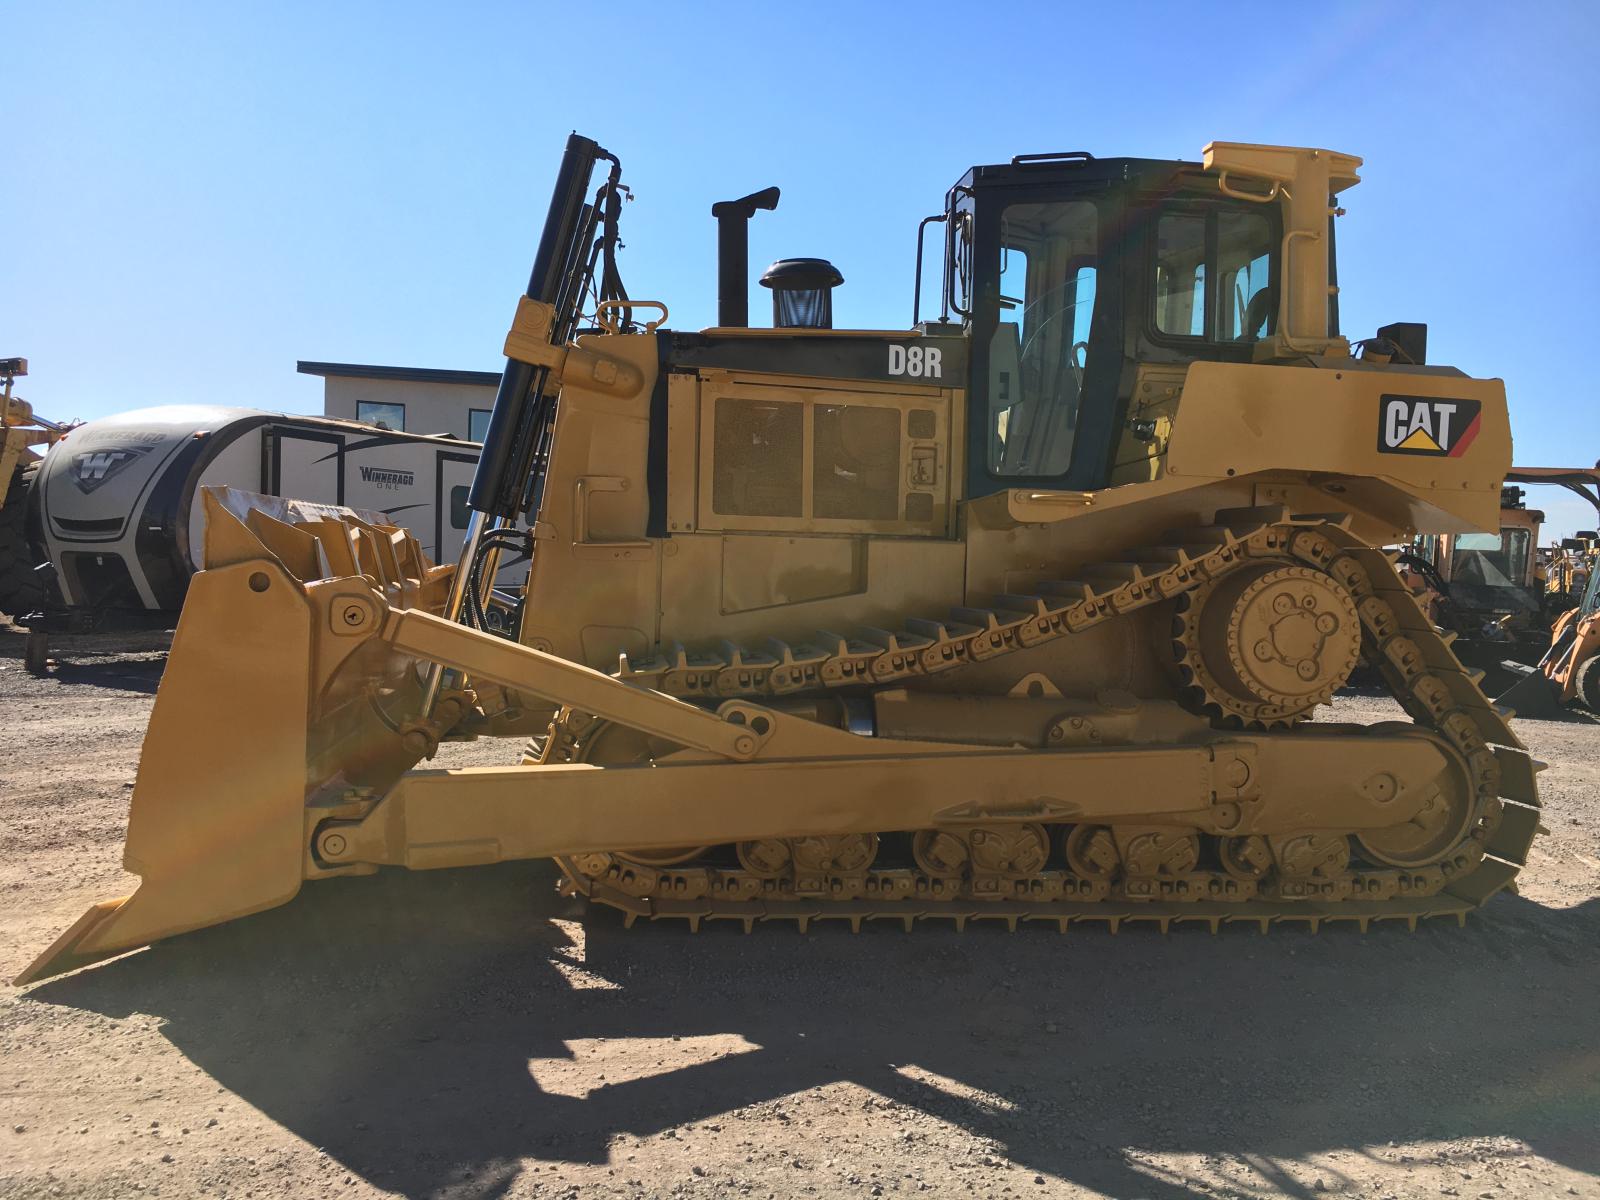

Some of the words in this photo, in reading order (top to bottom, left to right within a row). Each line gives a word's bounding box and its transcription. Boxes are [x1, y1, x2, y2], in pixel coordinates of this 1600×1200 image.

[888, 344, 942, 378] D8R
[1385, 400, 1457, 451] CAT
[359, 466, 415, 486] WINNEBAGO
